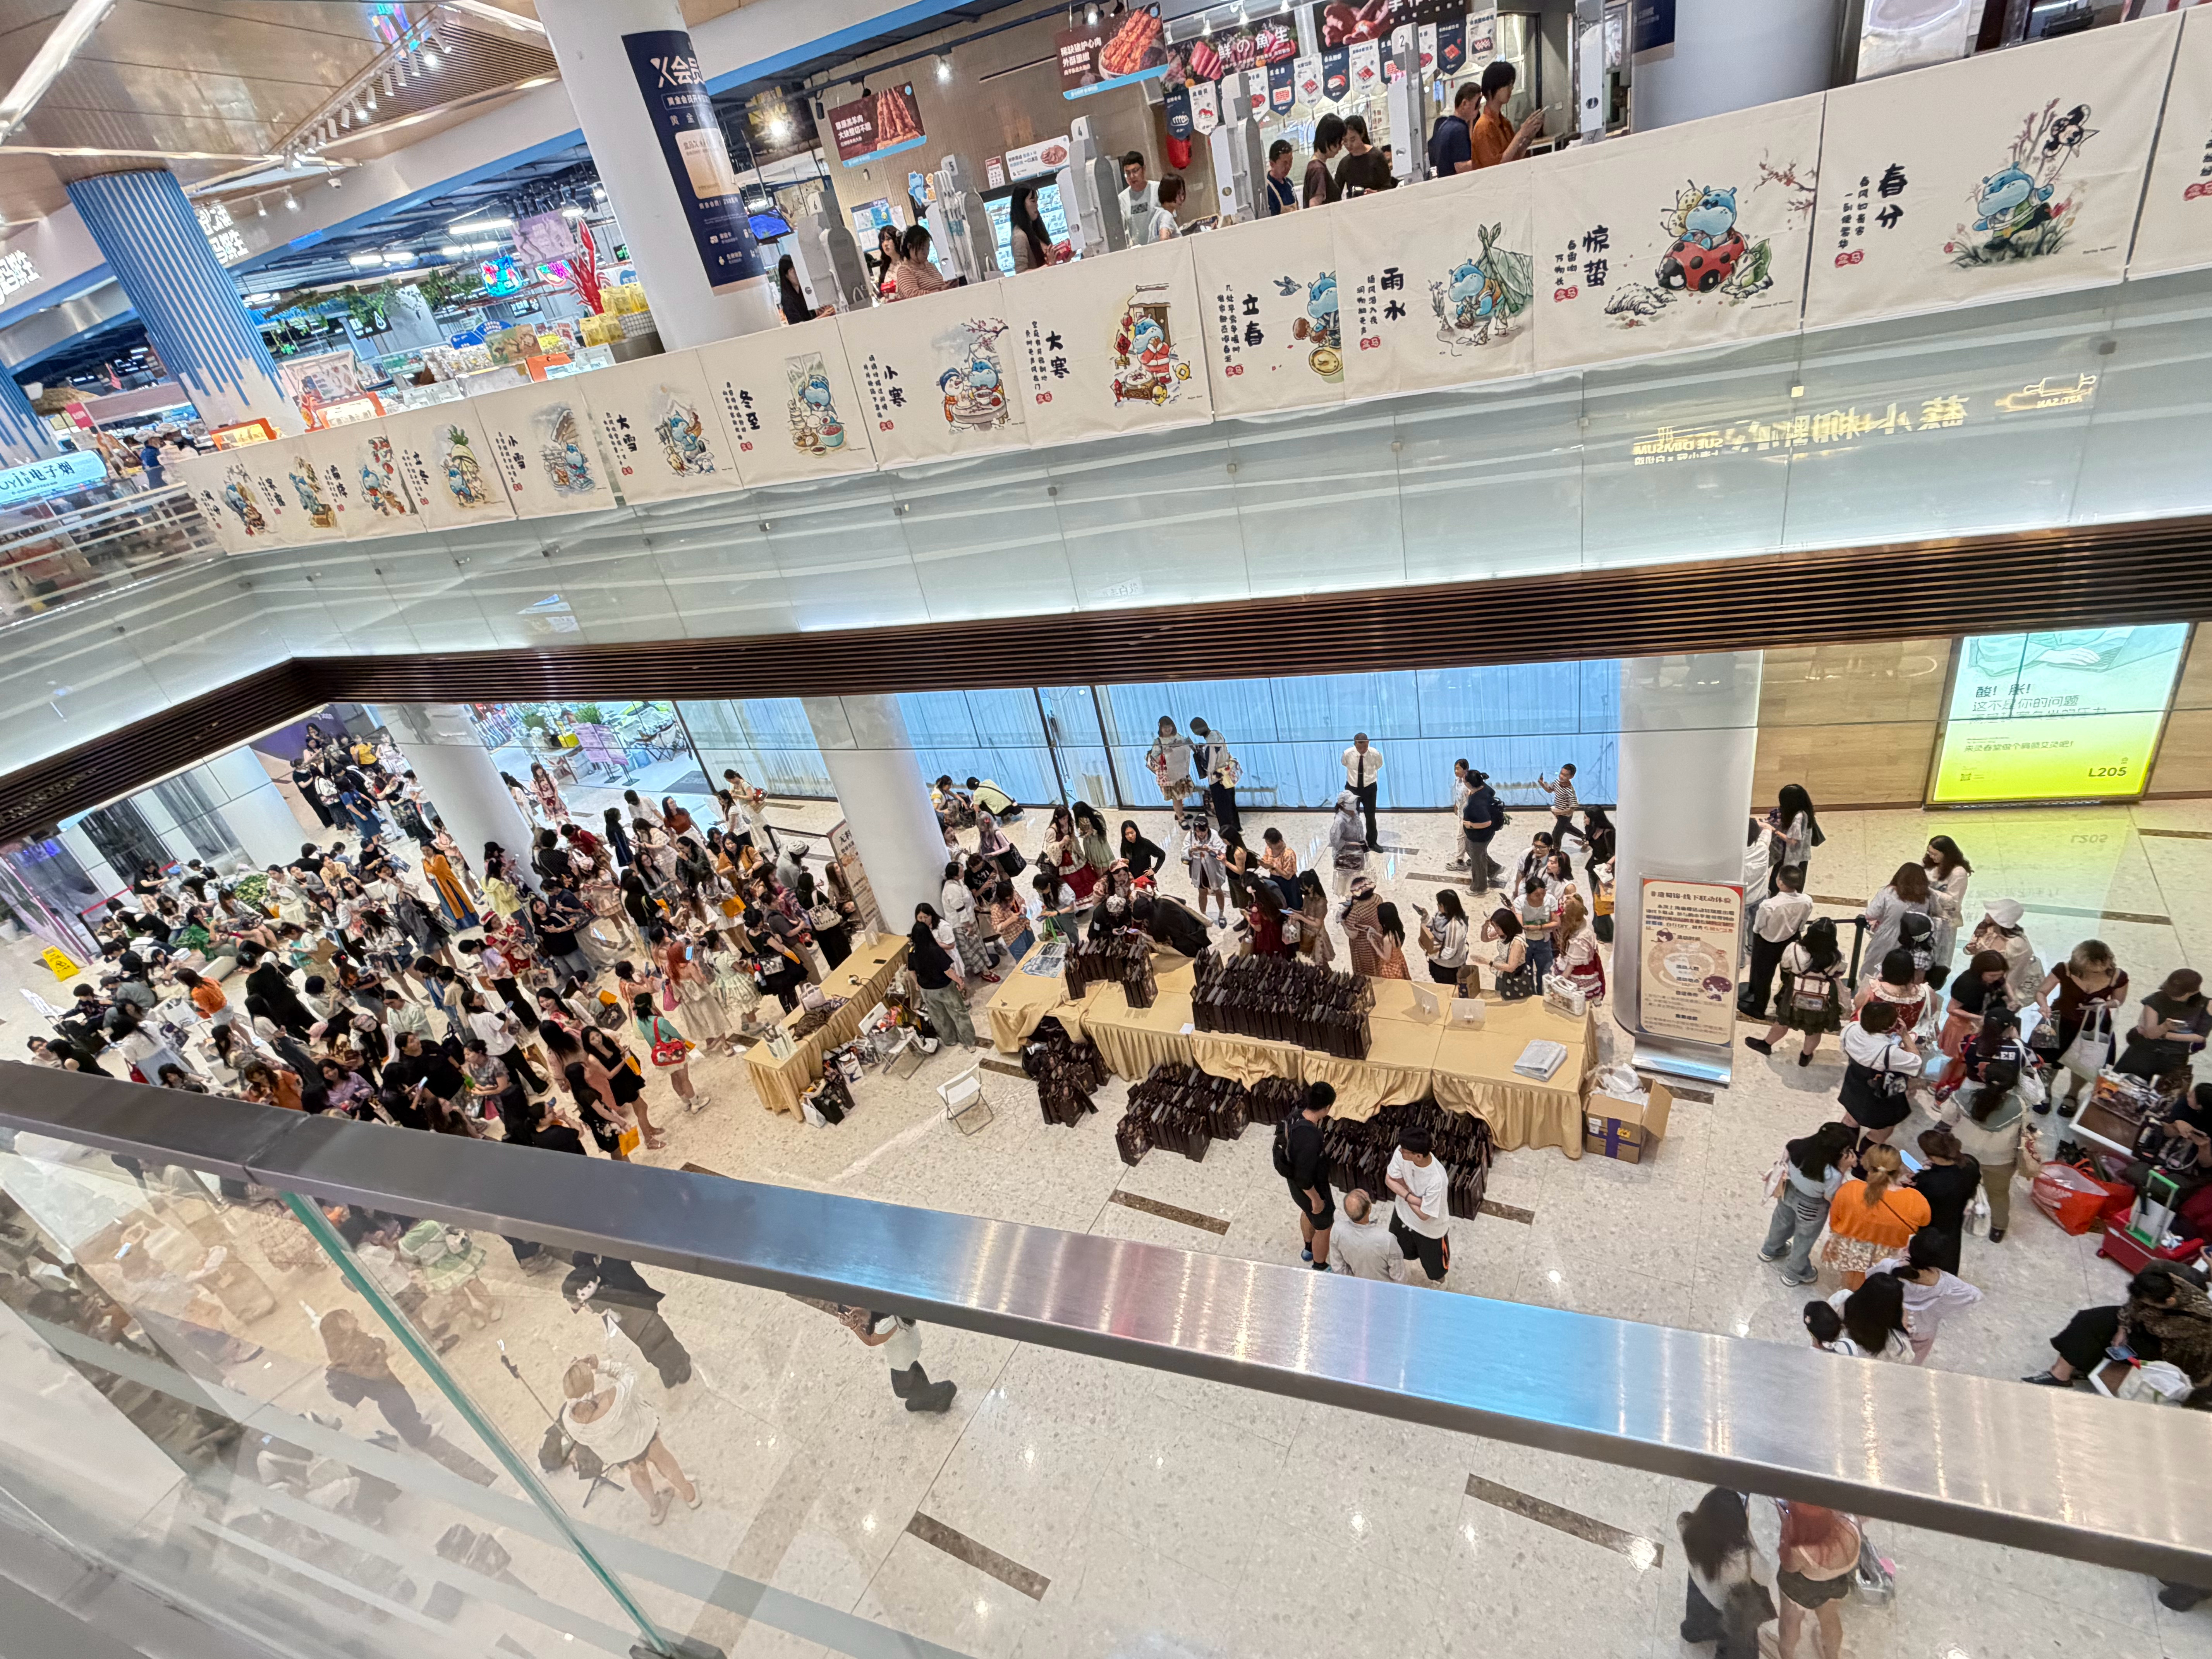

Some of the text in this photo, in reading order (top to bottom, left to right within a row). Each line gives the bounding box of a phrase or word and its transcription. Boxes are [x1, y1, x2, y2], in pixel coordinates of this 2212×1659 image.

[1400, 34, 1405, 47] 2
[1874, 163, 1908, 229] 春分
[1582, 225, 1610, 287] 惊蛰
[1381, 267, 1406, 321] 雨水
[1242, 294, 1264, 347] 立春
[1046, 330, 1070, 379] 大寒
[884, 366, 907, 407] 小寒
[740, 390, 761, 430] 冬至
[28, 461, 75, 481] 电子烟
[1972, 695, 2080, 711] 这不是你的问题
[2088, 767, 2127, 777] L205
